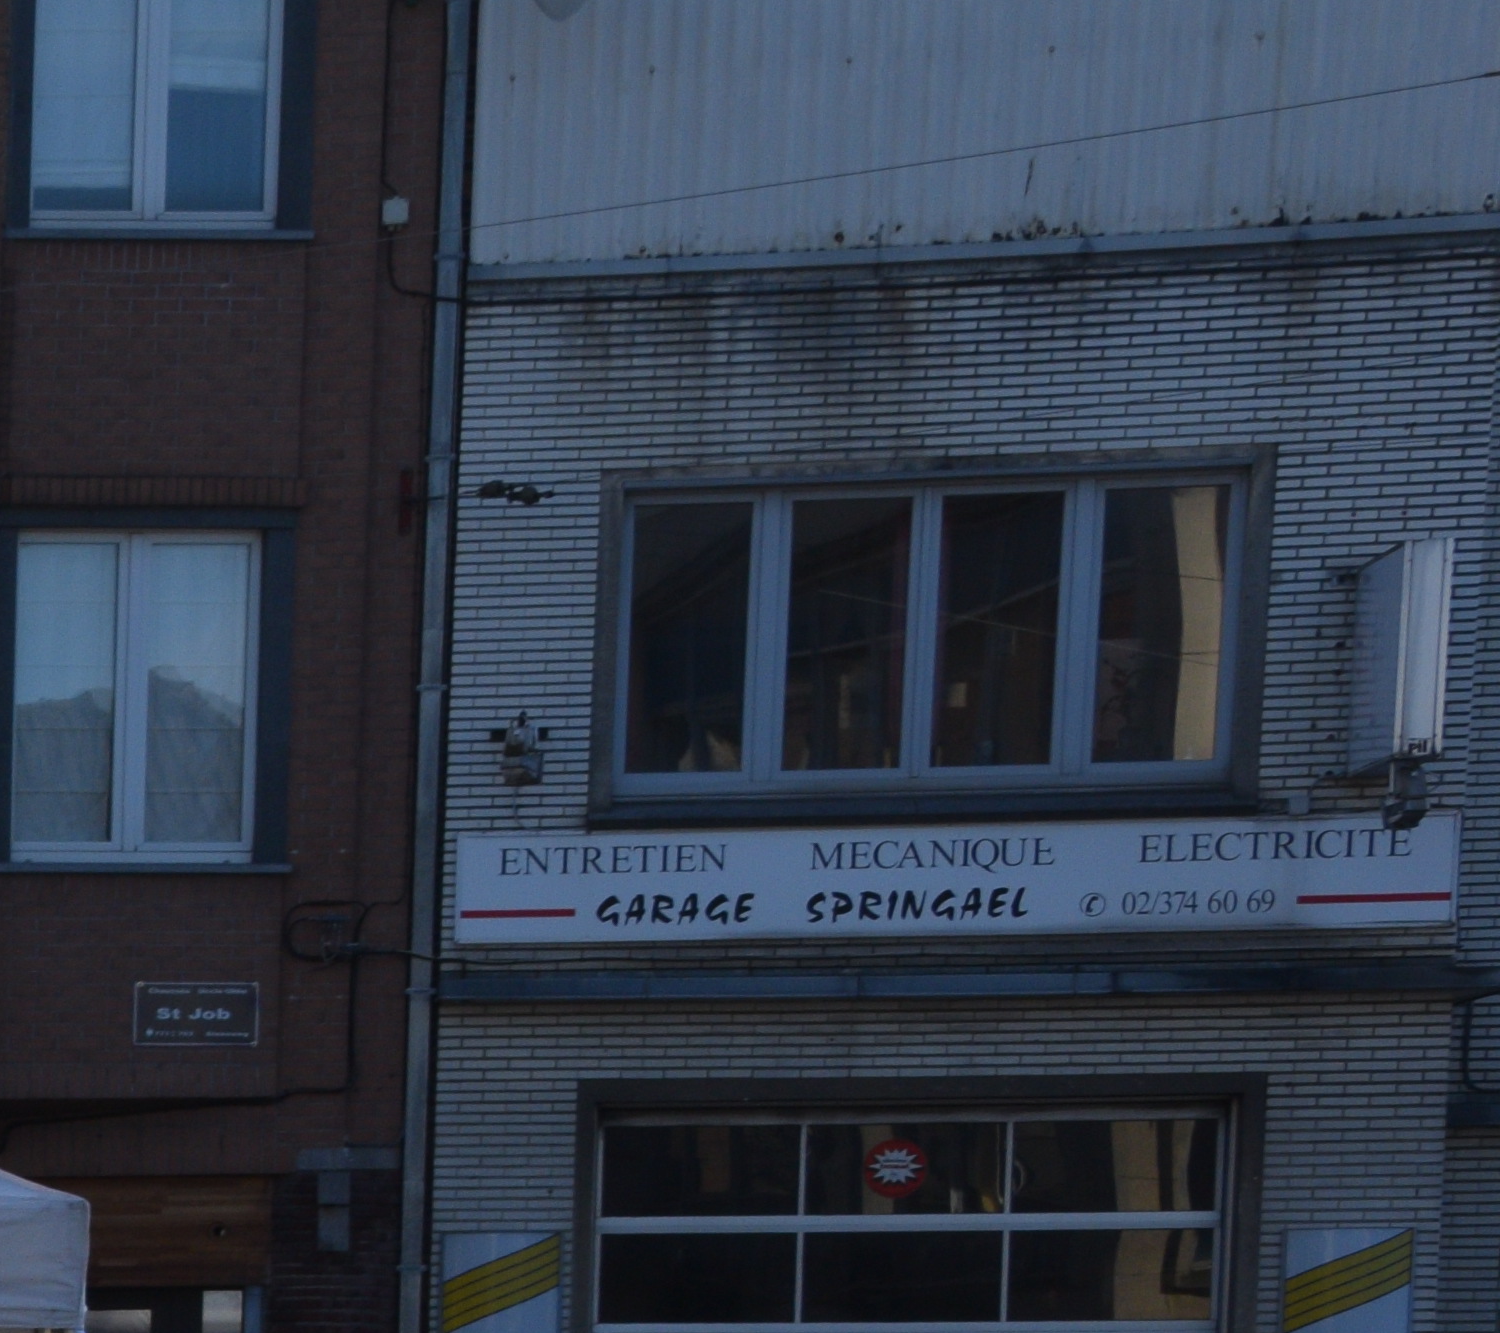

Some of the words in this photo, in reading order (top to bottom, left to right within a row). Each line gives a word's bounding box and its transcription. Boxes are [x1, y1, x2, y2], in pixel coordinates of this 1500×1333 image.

[499, 842, 729, 878] ENTRETIEN
[809, 835, 1056, 873] MECANIQUE
[596, 892, 756, 926] GARAGE
[805, 887, 1030, 924] SPRINGAEL
[1121, 889, 1198, 916] 02/374
[1207, 888, 1237, 914] 60
[1246, 886, 1276, 912] 69
[156, 1007, 181, 1020] St
[188, 1007, 231, 1020] Job
